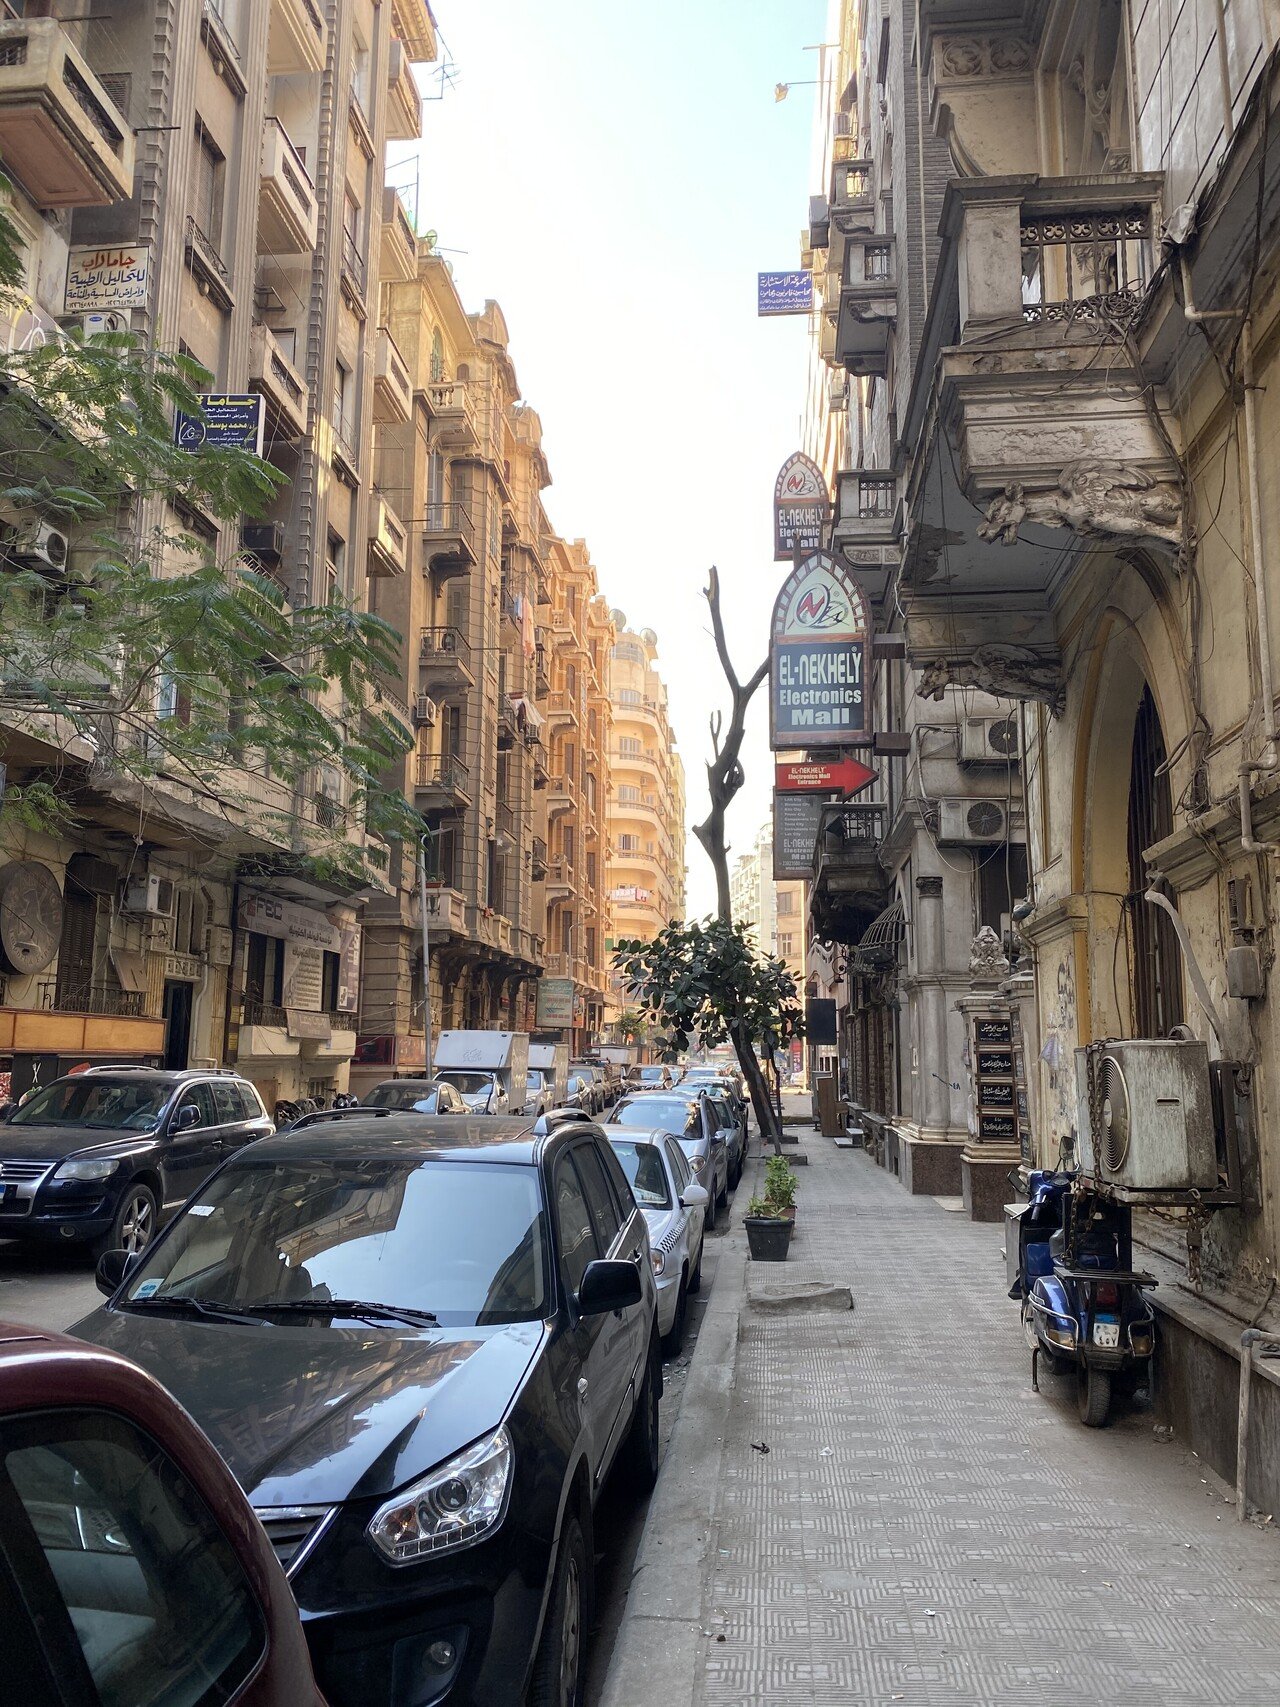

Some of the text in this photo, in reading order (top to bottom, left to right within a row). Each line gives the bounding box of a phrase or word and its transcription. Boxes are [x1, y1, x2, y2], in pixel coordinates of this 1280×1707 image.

[69, 268, 146, 289] للتحاليل الطبية
[779, 652, 862, 685] EL-NEKHELY
[779, 688, 862, 706] Electronics
[791, 708, 850, 726] Mall
